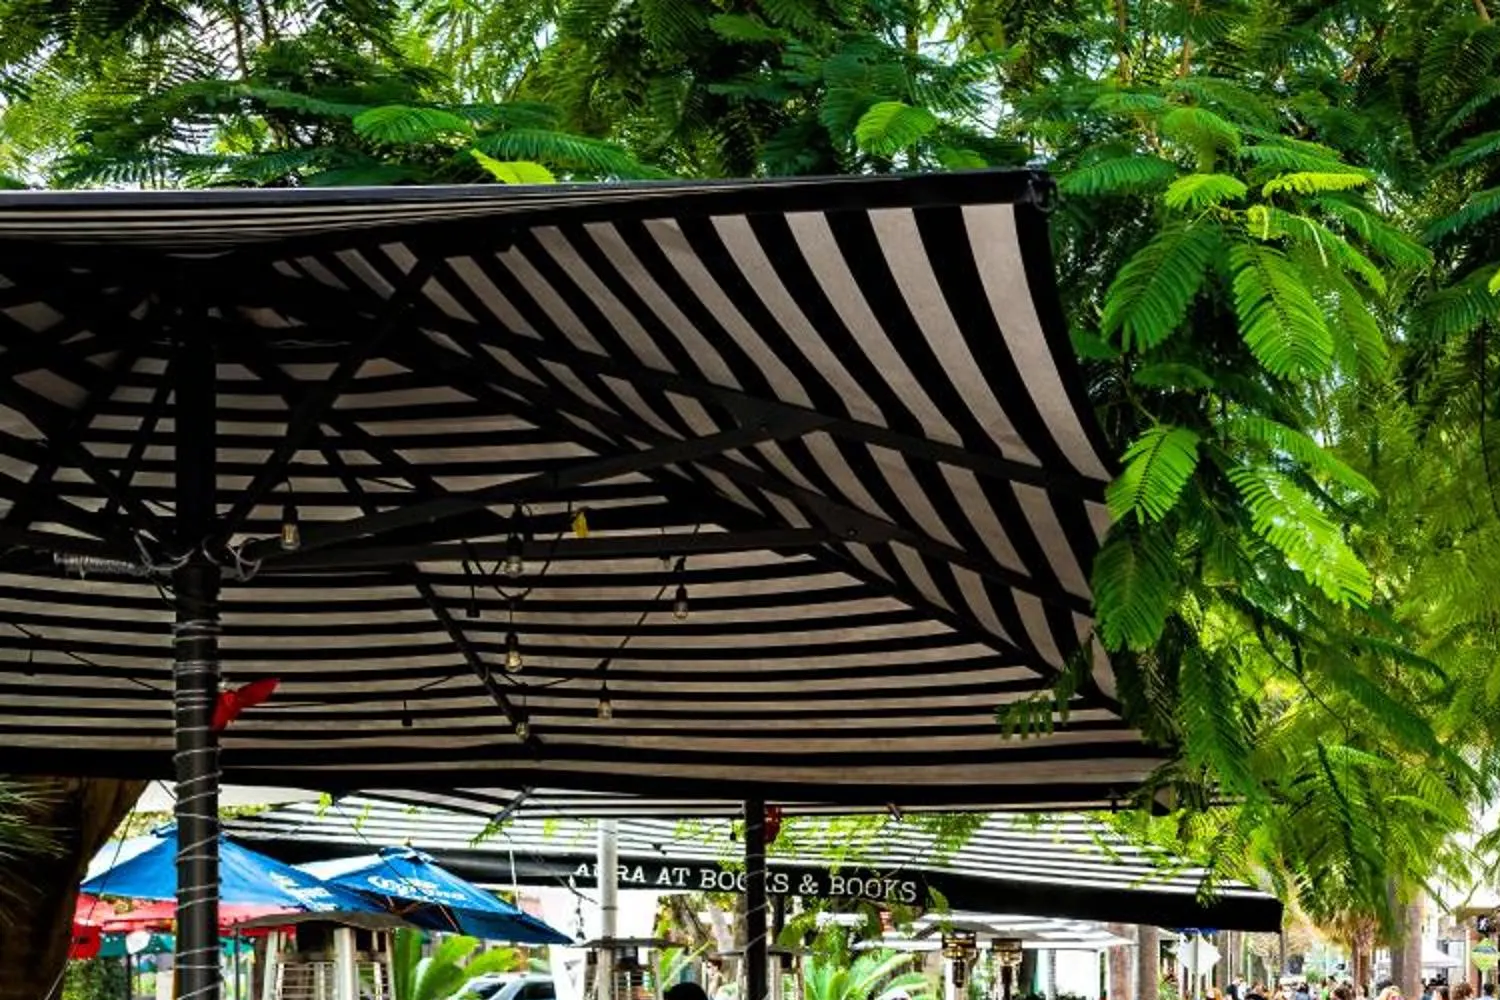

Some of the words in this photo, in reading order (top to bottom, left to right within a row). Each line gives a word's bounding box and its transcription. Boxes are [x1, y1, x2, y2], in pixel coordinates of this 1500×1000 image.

[655, 866, 691, 887] AT
[799, 874, 819, 895] &
[828, 875, 917, 903] BOOKS
